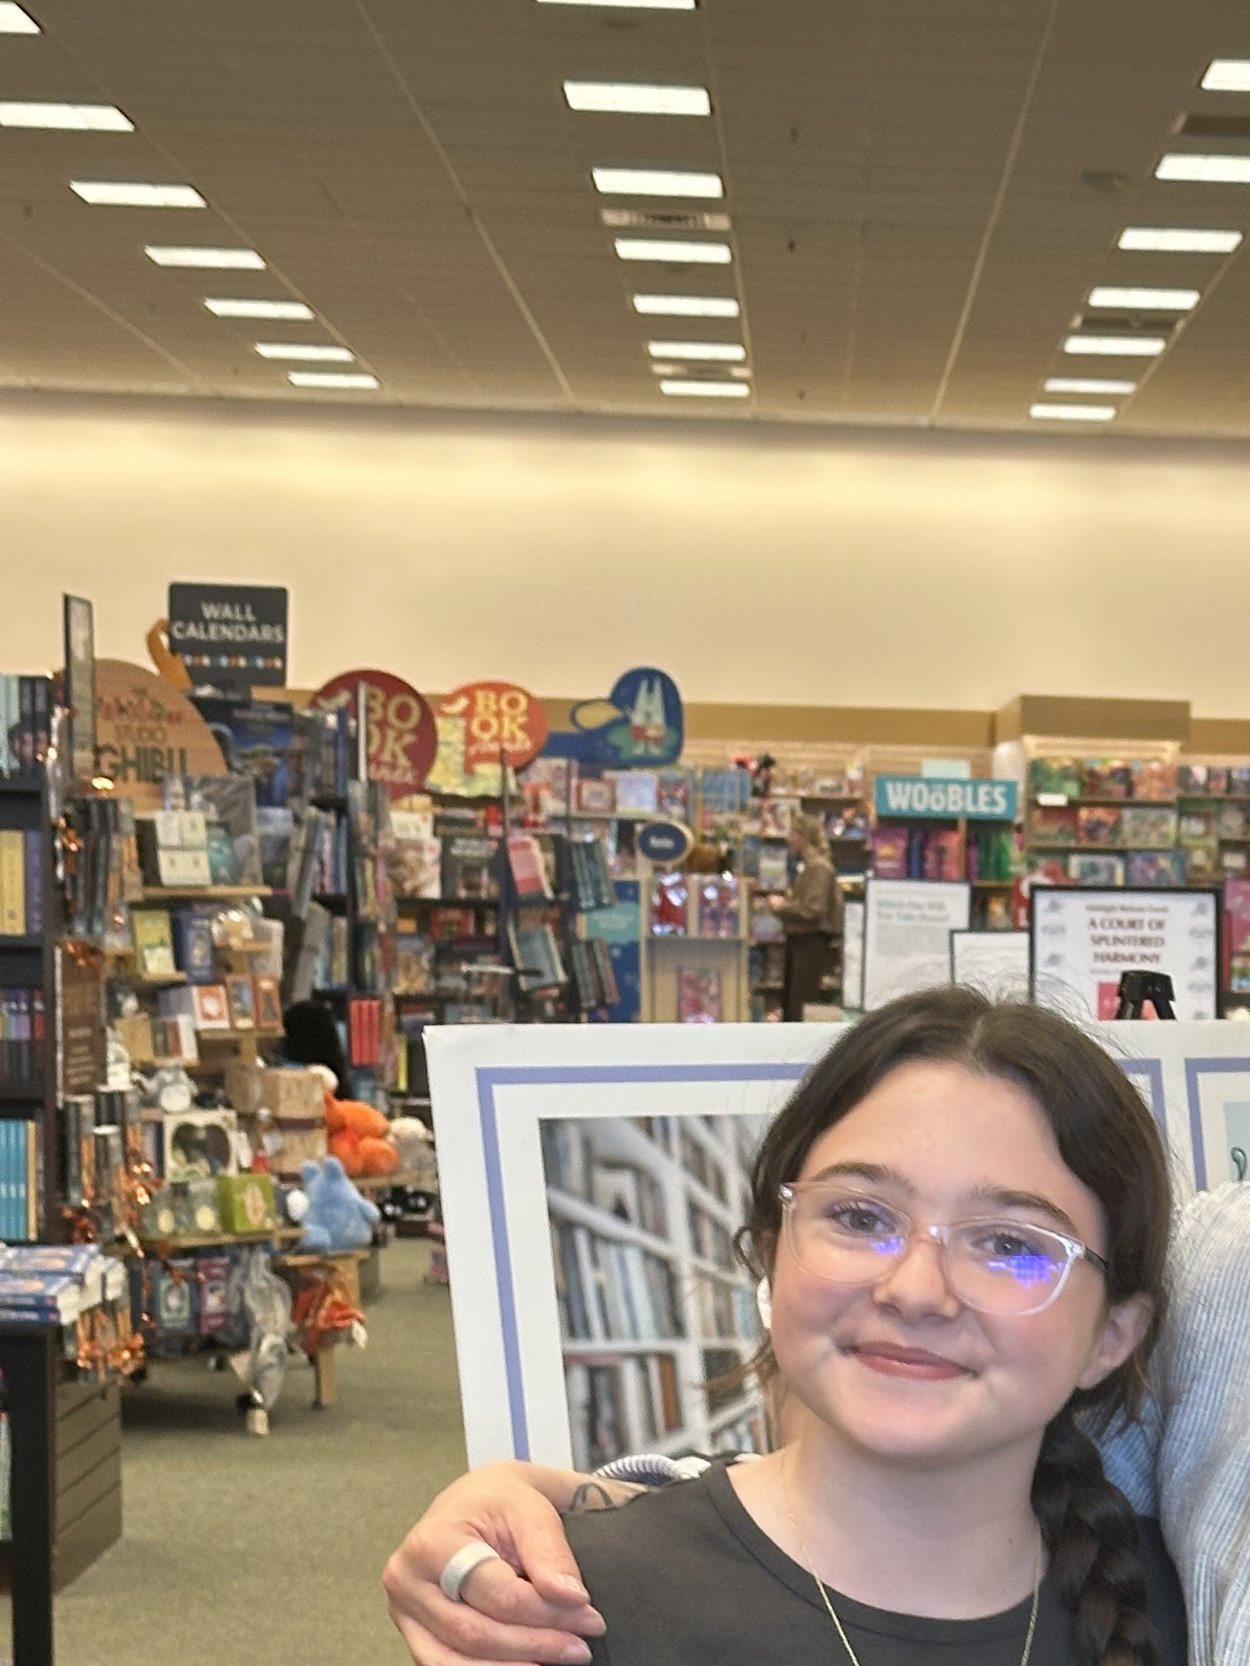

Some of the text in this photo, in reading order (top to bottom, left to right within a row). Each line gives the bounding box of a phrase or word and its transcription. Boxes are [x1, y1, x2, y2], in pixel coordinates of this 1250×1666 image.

[201, 602, 257, 622] WALL
[172, 621, 284, 643] CALENDARS
[1088, 918, 1166, 930] A COURT OF
[1090, 935, 1165, 947] SPLINTERED
[1093, 951, 1162, 964] HARMONY
